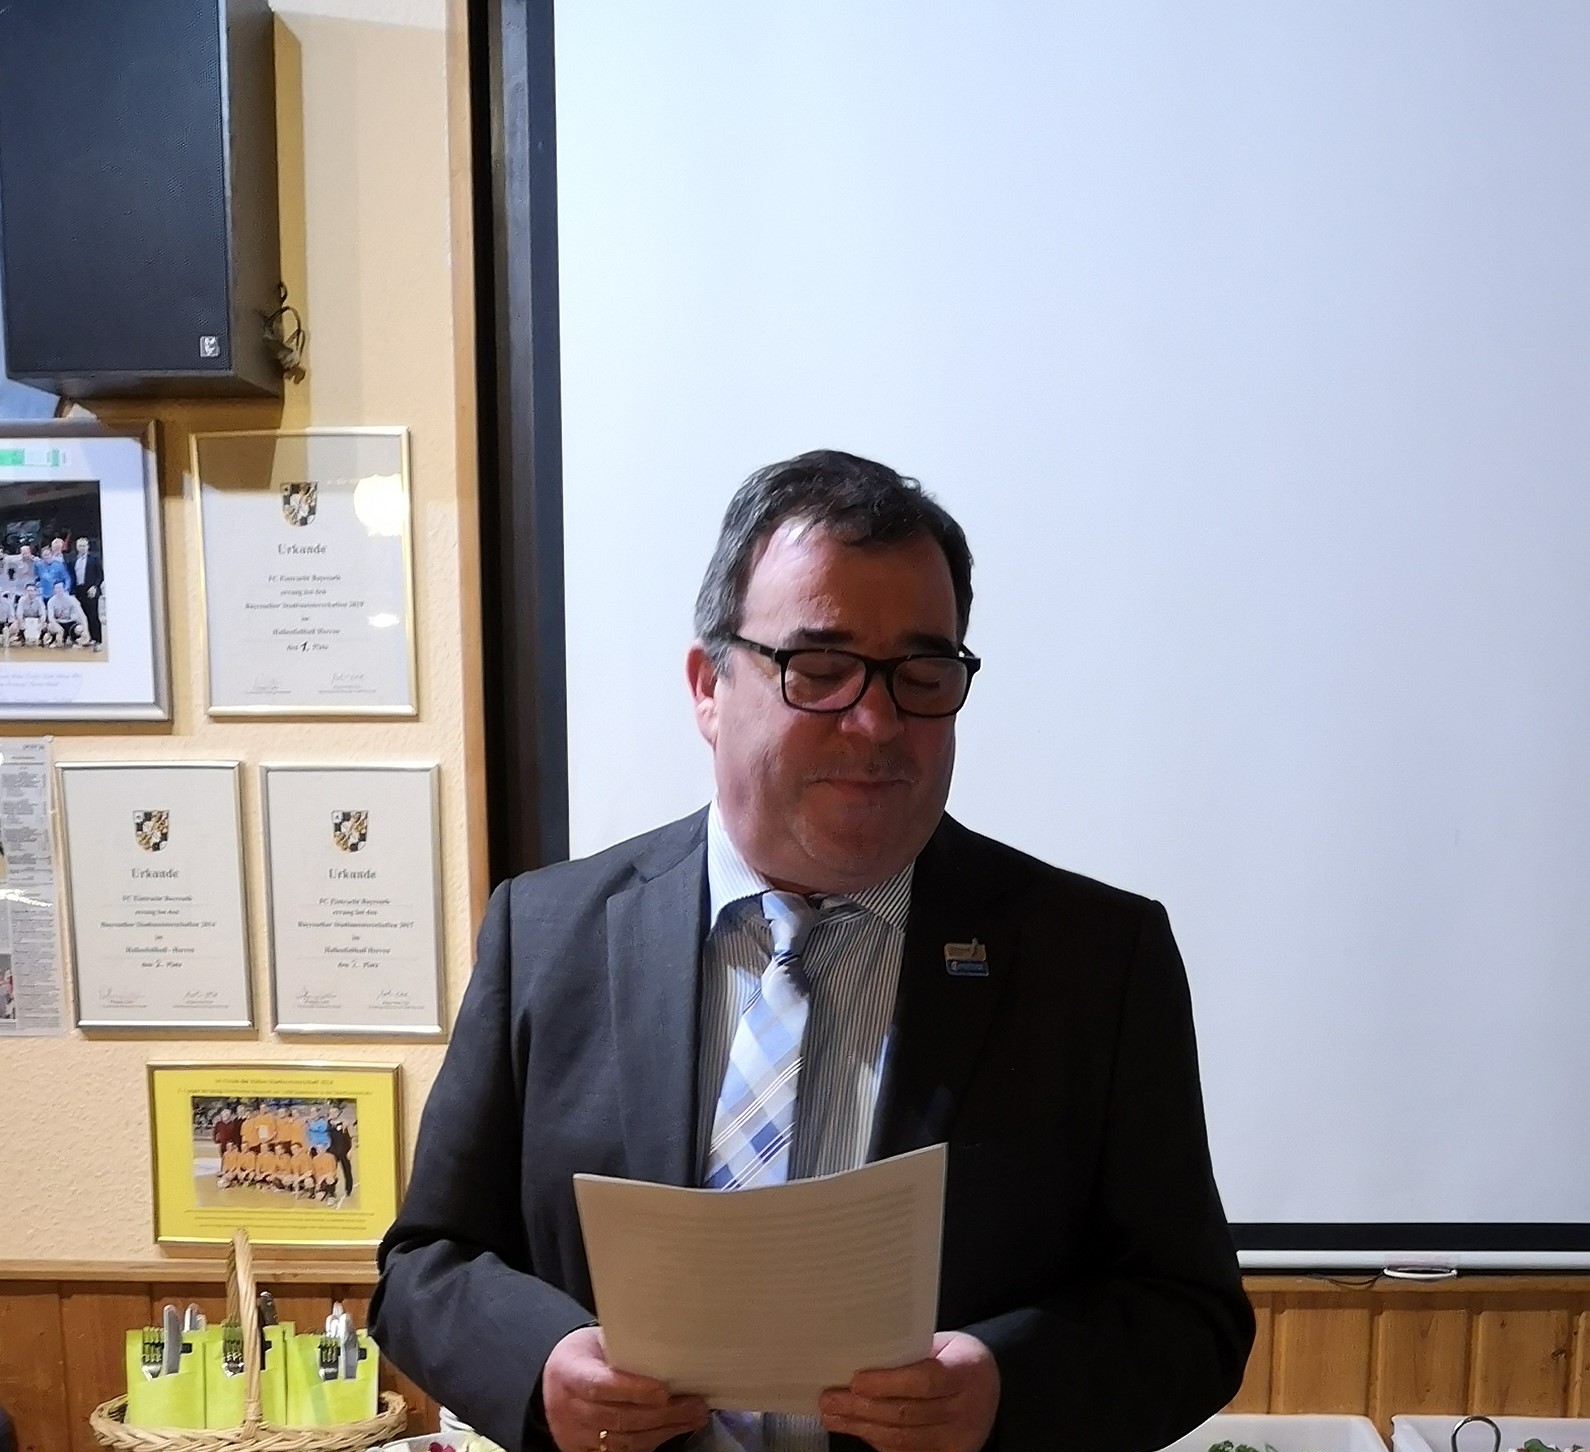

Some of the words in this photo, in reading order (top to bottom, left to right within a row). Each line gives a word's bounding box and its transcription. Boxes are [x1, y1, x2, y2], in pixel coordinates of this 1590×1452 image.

[278, 543, 327, 555] Urkunde
[131, 868, 180, 879] Urkunde
[329, 868, 377, 879] Urkunde
